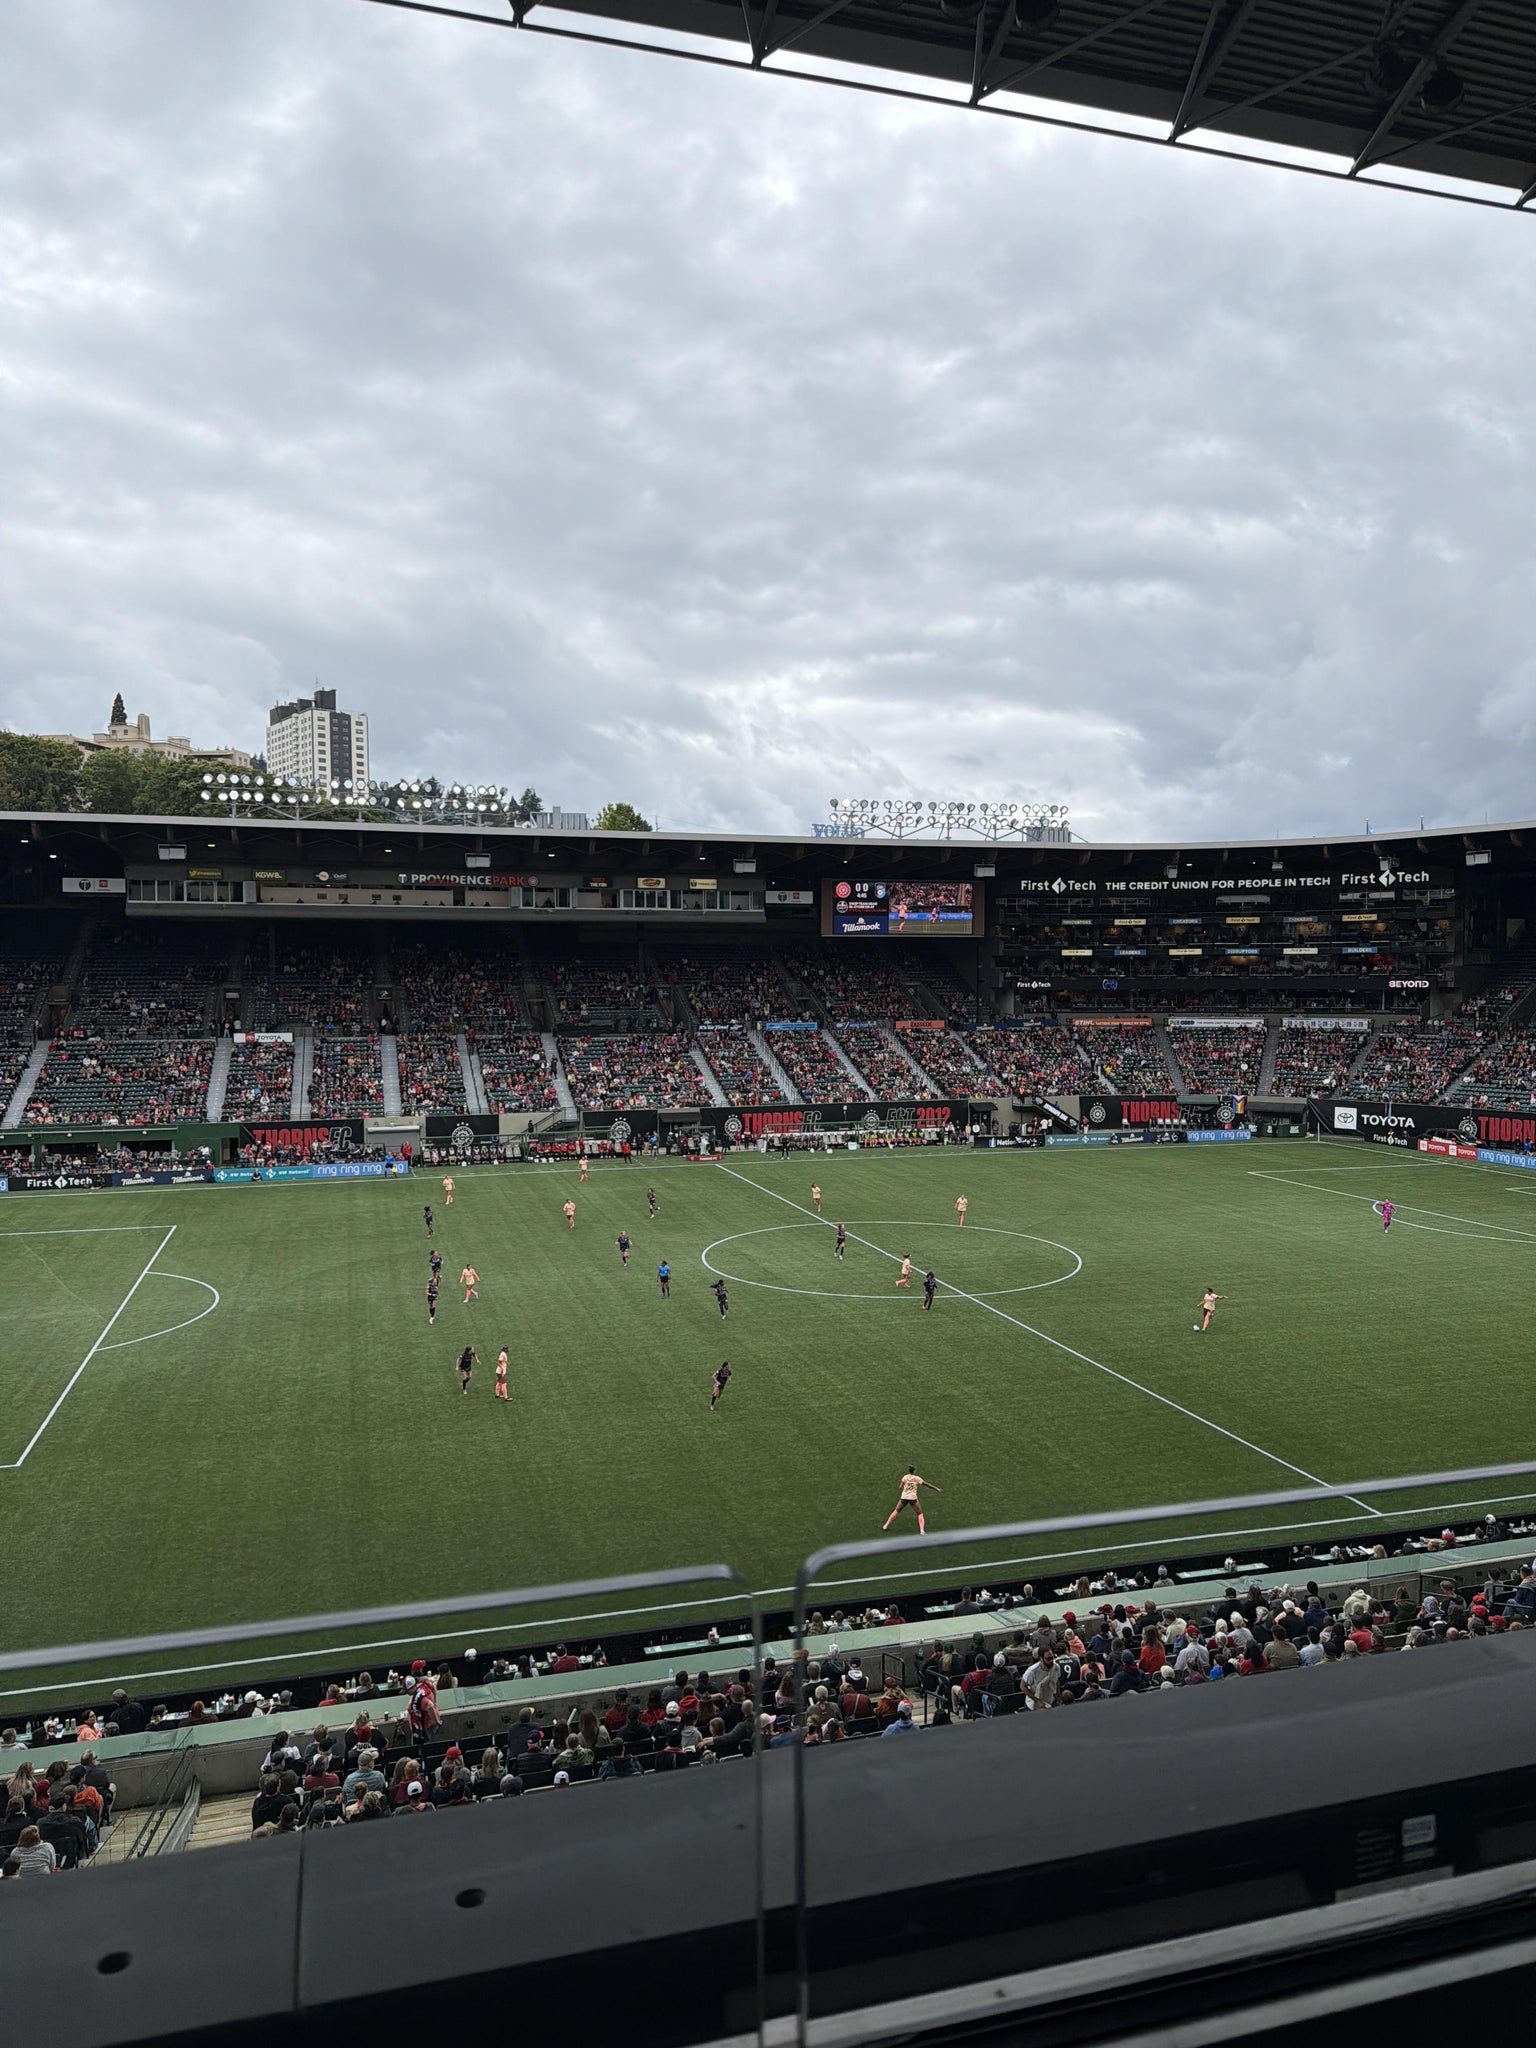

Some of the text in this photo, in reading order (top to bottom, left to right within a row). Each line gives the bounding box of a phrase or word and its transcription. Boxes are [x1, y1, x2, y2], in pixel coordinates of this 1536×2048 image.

[1105, 877, 1331, 890] THE CREDIT UNION FOR PEOPLE IN TECH
[1341, 871, 1430, 885] First Tech
[855, 883, 868, 892] 0 0
[1020, 880, 1096, 891] First Tech
[842, 922, 880, 933] Tillamook
[1388, 980, 1429, 988] BEYOND
[916, 1106, 951, 1129] 2012
[1121, 1101, 1180, 1122] THORNS
[742, 1111, 802, 1133] THORNS
[1361, 1114, 1415, 1128] TOYOTA
[252, 1127, 329, 1154] THORNS
[1201, 1131, 1215, 1141] ring
[1221, 1130, 1250, 1140] ring ring
[1373, 1134, 1408, 1146] First Tech
[1458, 1148, 1476, 1156] TOYOTA
[1481, 1151, 1494, 1162] ring
[1496, 1153, 1510, 1165] ring
[1511, 1155, 1525, 1167] ring
[318, 1166, 337, 1176] ring
[340, 1165, 360, 1175] ring
[362, 1164, 382, 1174] ring
[27, 1177, 93, 1188] First Tech
[121, 1176, 155, 1185] Tillamook
[171, 1174, 205, 1184] Tillamook
[1064, 1664, 1072, 1679] 9
